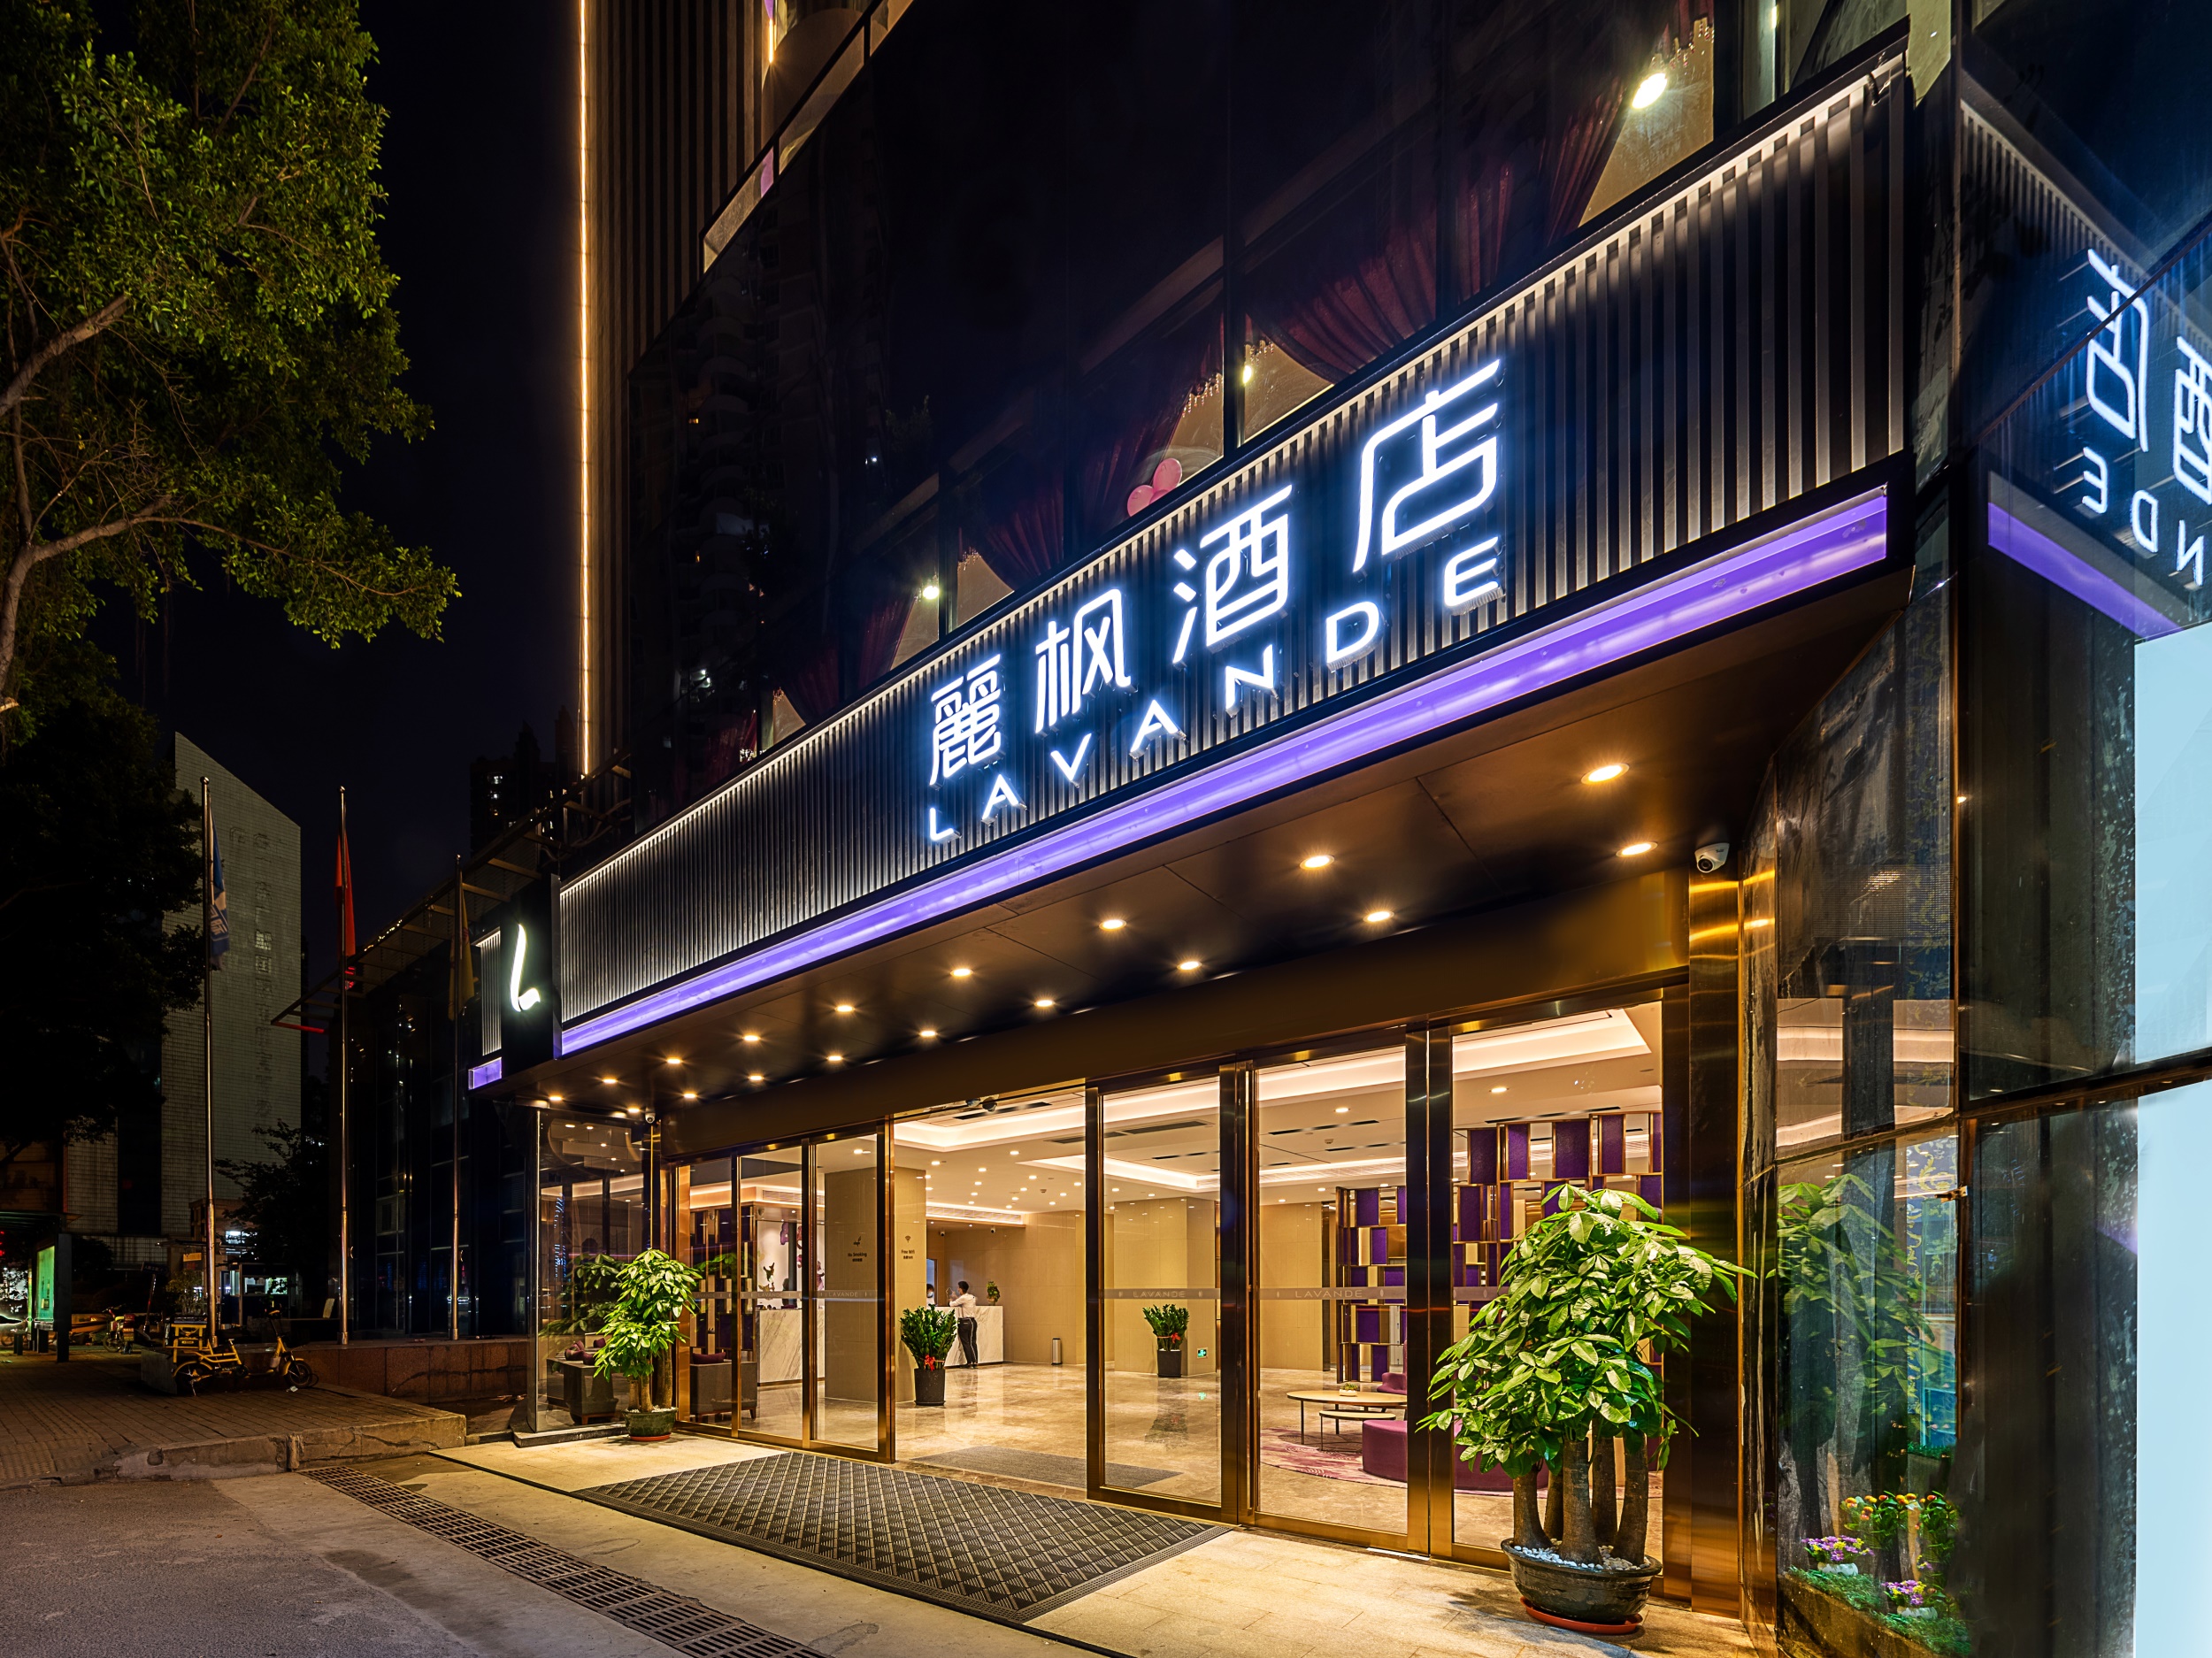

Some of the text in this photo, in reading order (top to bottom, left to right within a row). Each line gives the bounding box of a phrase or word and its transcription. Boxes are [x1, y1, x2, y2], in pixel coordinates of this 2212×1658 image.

[928, 357, 1501, 787] 麗枫酒店
[929, 535, 1500, 842] LAVANDE
[1294, 1289, 1363, 1298] LAVANDE
